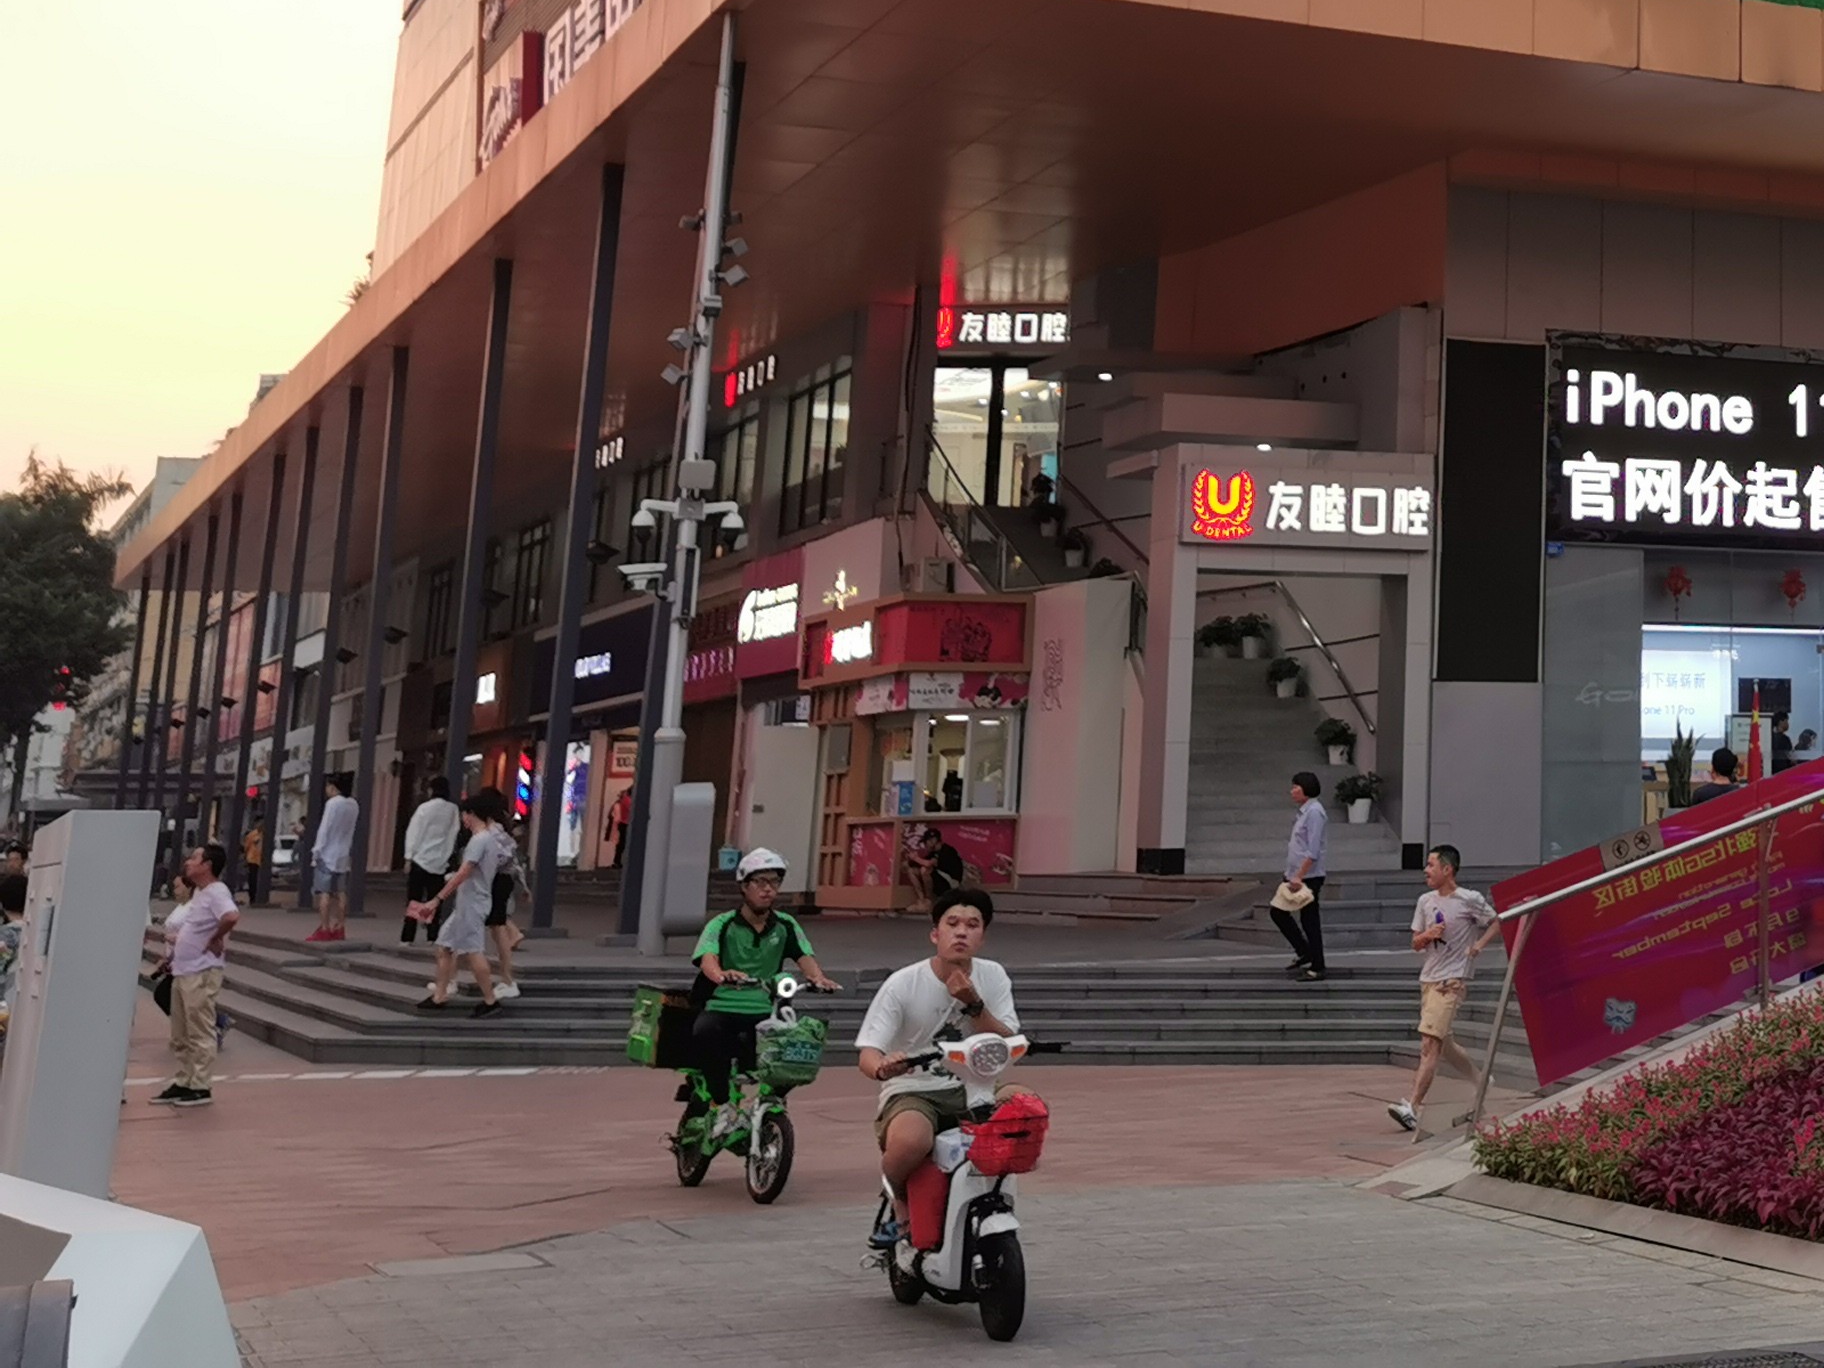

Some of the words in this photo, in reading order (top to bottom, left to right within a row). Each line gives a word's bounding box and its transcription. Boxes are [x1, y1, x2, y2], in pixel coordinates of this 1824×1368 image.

[959, 311, 1070, 342] 友睦口腔
[1566, 368, 1754, 434] iPhone
[1266, 481, 1430, 535] 友睦口腔
